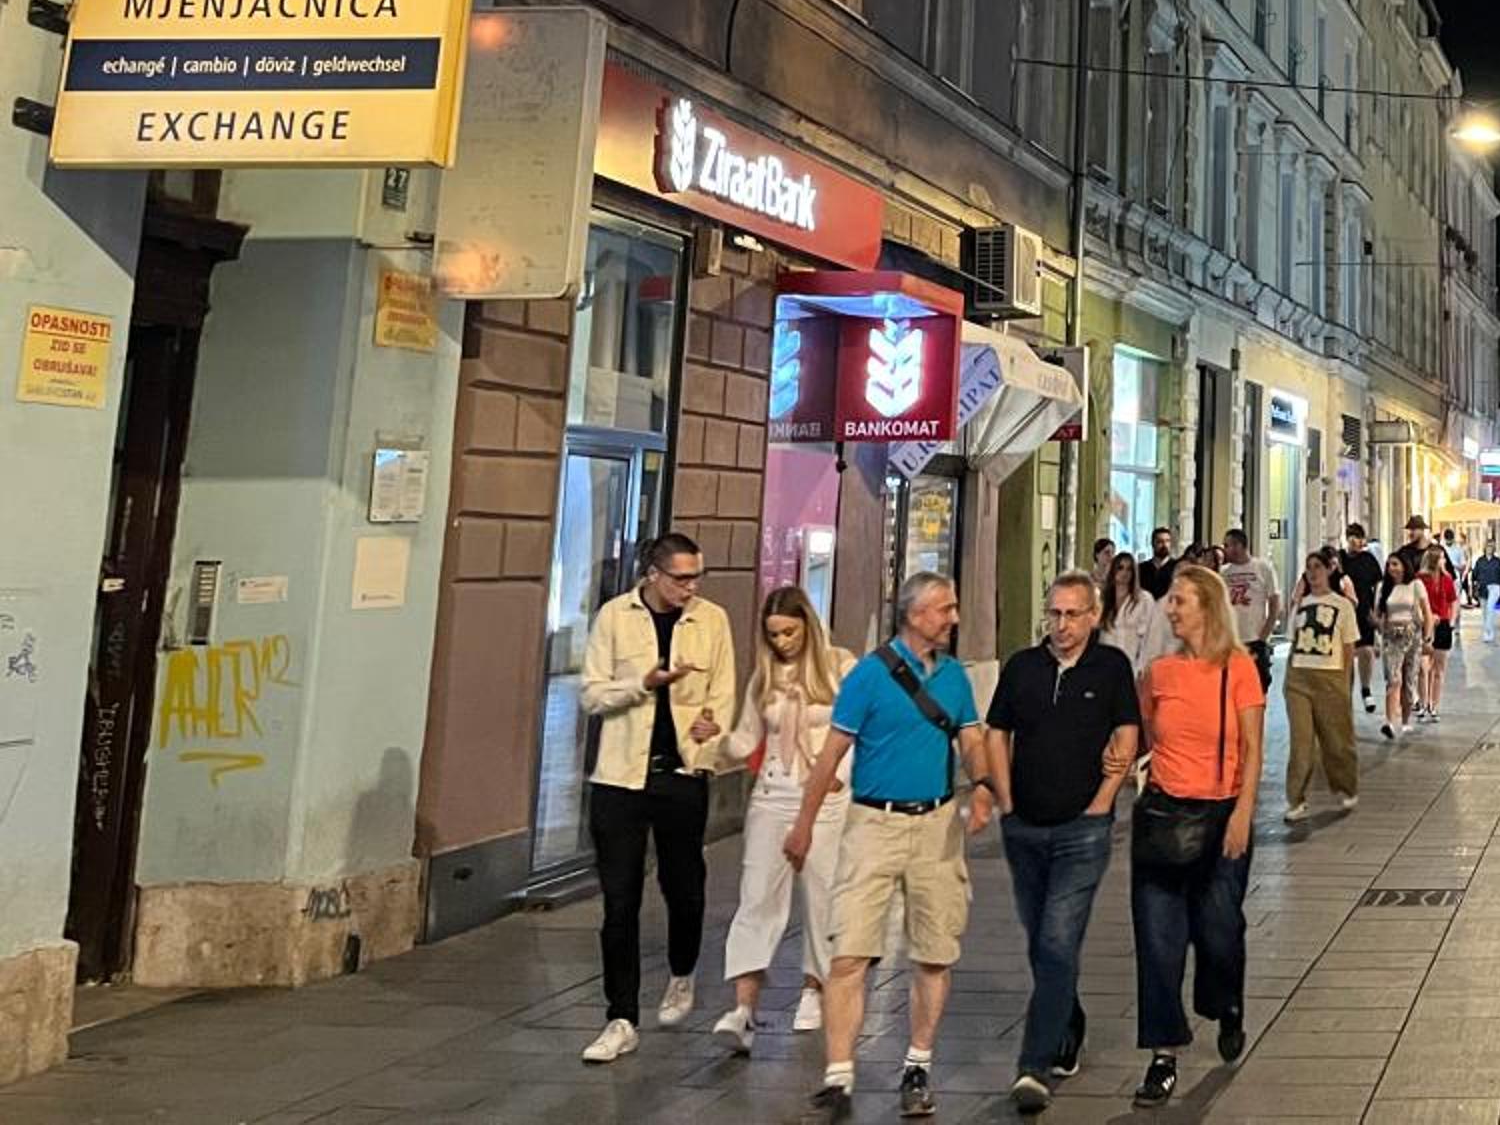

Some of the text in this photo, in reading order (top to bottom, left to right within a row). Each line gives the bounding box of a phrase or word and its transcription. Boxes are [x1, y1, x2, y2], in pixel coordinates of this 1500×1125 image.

[102, 55, 165, 78] echangé
[183, 56, 237, 75] cambio
[313, 54, 406, 76] geldwechsel
[136, 110, 352, 143] EXCHANGE
[386, 168, 407, 188] 27
[699, 126, 818, 233] ZiraatBank
[844, 420, 940, 437] BANKOMAT
